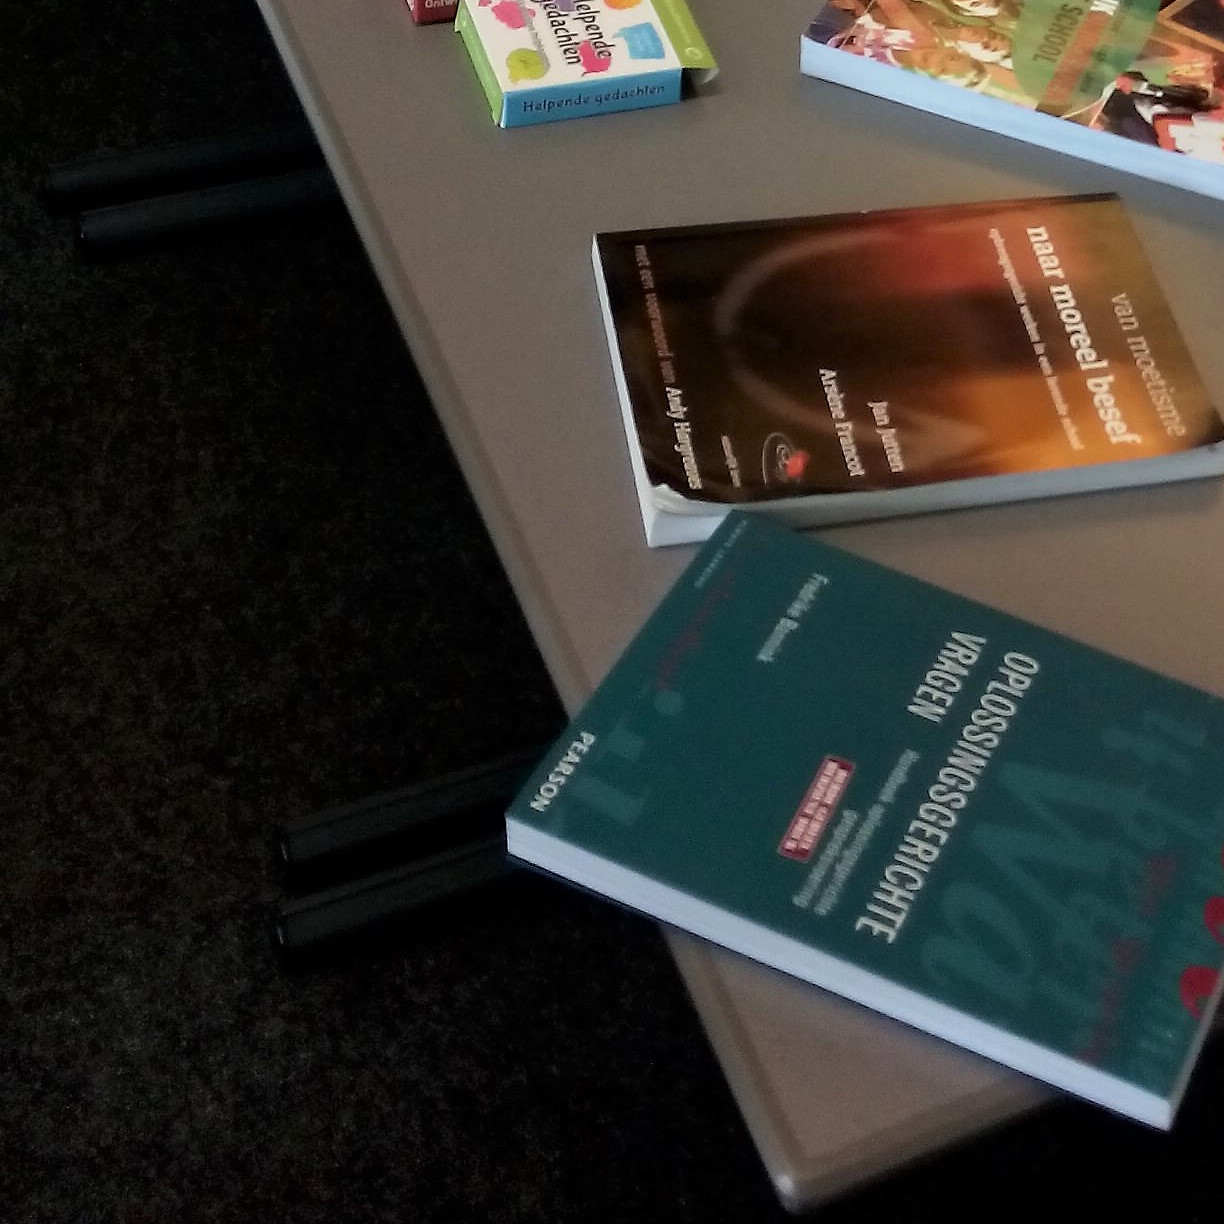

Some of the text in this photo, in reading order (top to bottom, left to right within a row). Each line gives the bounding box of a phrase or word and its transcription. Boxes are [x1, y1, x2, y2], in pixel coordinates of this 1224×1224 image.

[1032, 3, 1084, 62] SCHOOL
[523, 85, 665, 113] Helpende gedachten
[635, 244, 650, 267] met
[665, 386, 688, 419] Andy
[1026, 226, 1142, 445] naar moreel besef
[1112, 292, 1186, 437] van moetisme
[835, 420, 865, 477] Francot
[867, 400, 905, 474] Jan Jutten
[907, 630, 987, 723] VRAGEN
[530, 731, 596, 813] PEARSON
[855, 649, 1040, 945] OPLOSSINGSGERICHTE
